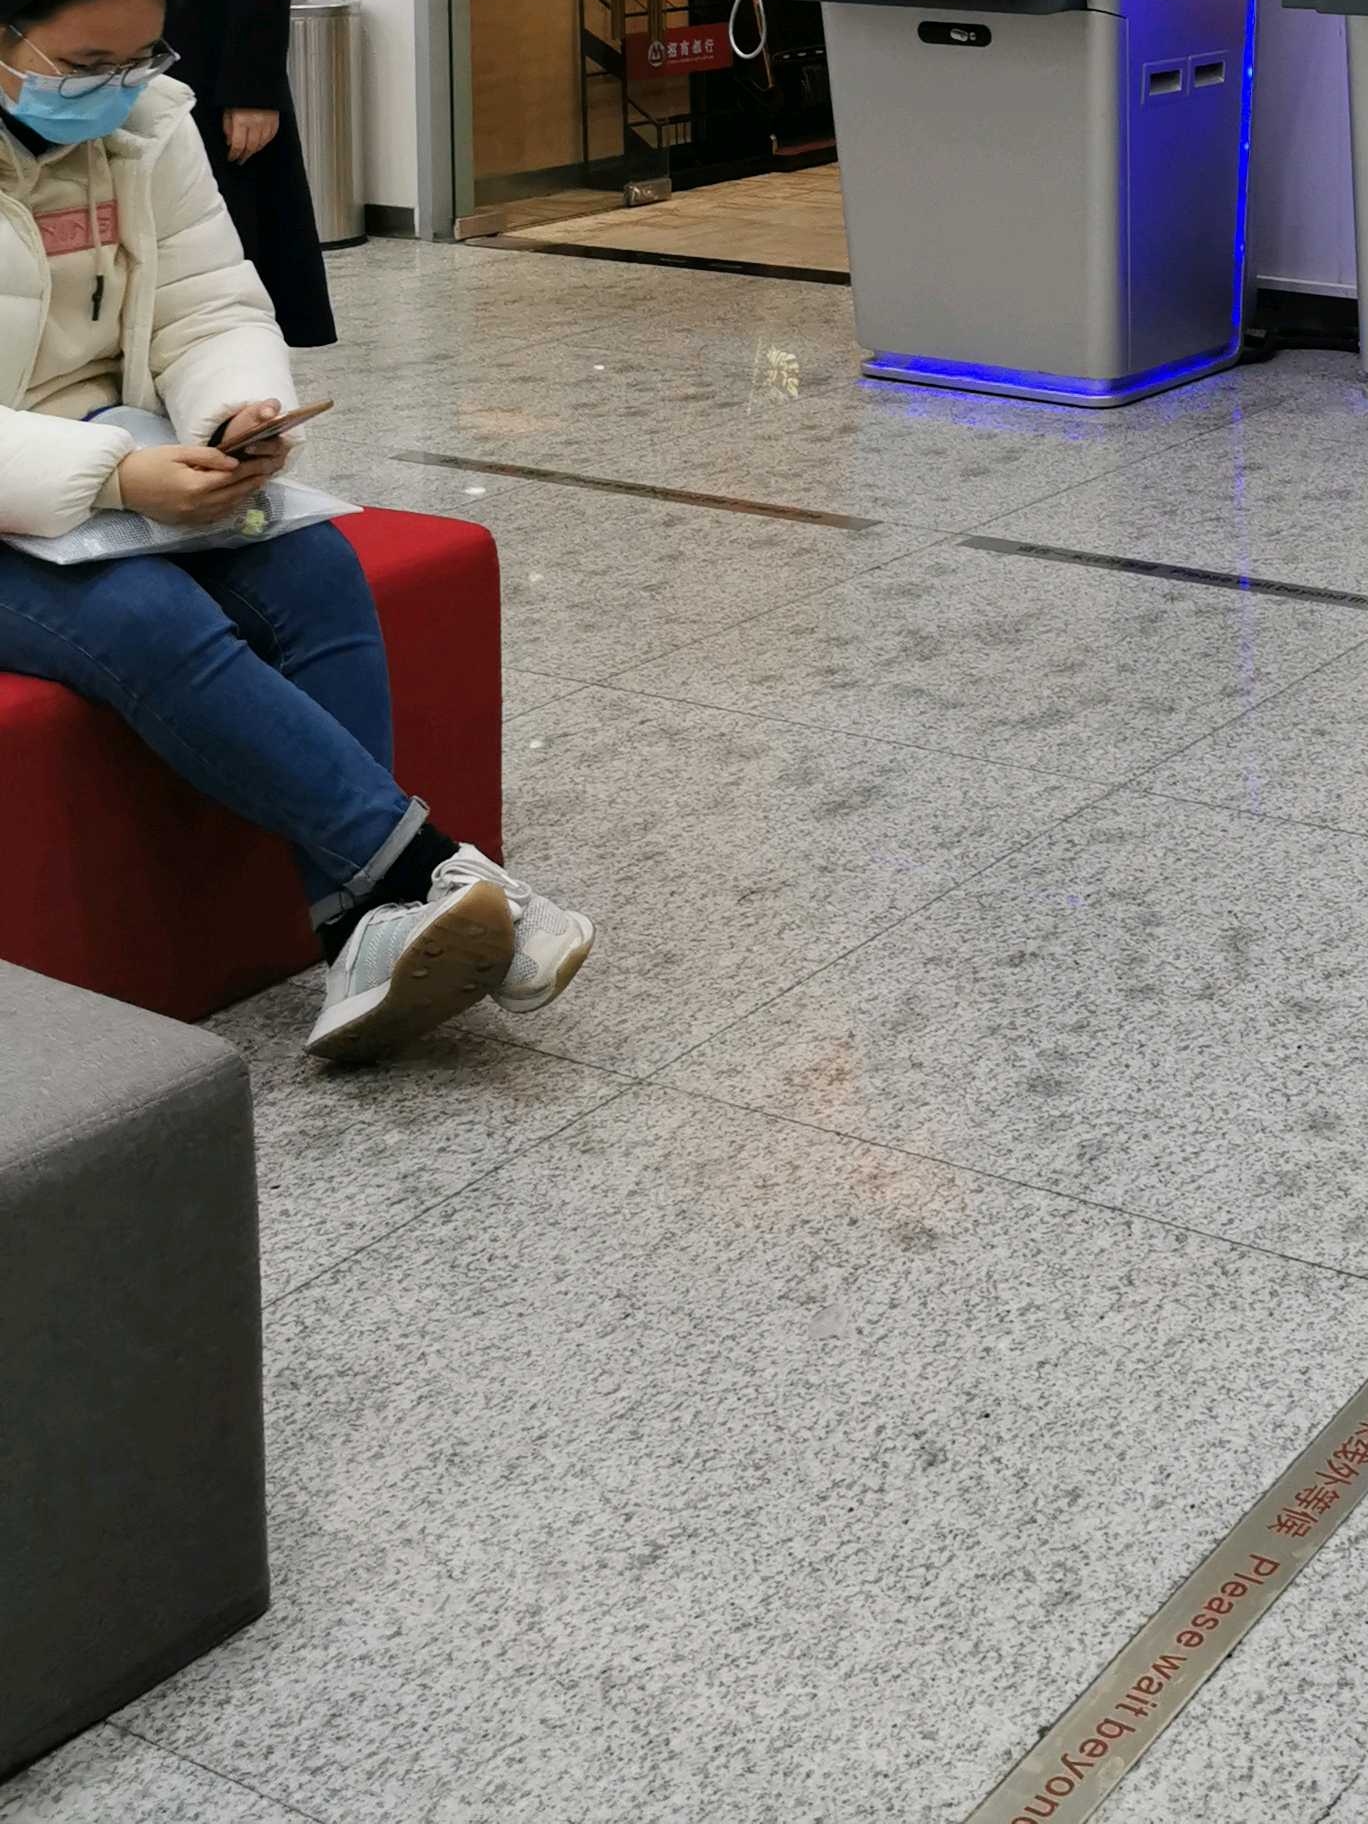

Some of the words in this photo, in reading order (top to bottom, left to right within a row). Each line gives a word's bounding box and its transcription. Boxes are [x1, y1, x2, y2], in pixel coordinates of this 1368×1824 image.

[1176, 1553, 1281, 1649] Please
[1115, 1653, 1187, 1717] wait
[1010, 1717, 1137, 1824] beyon
